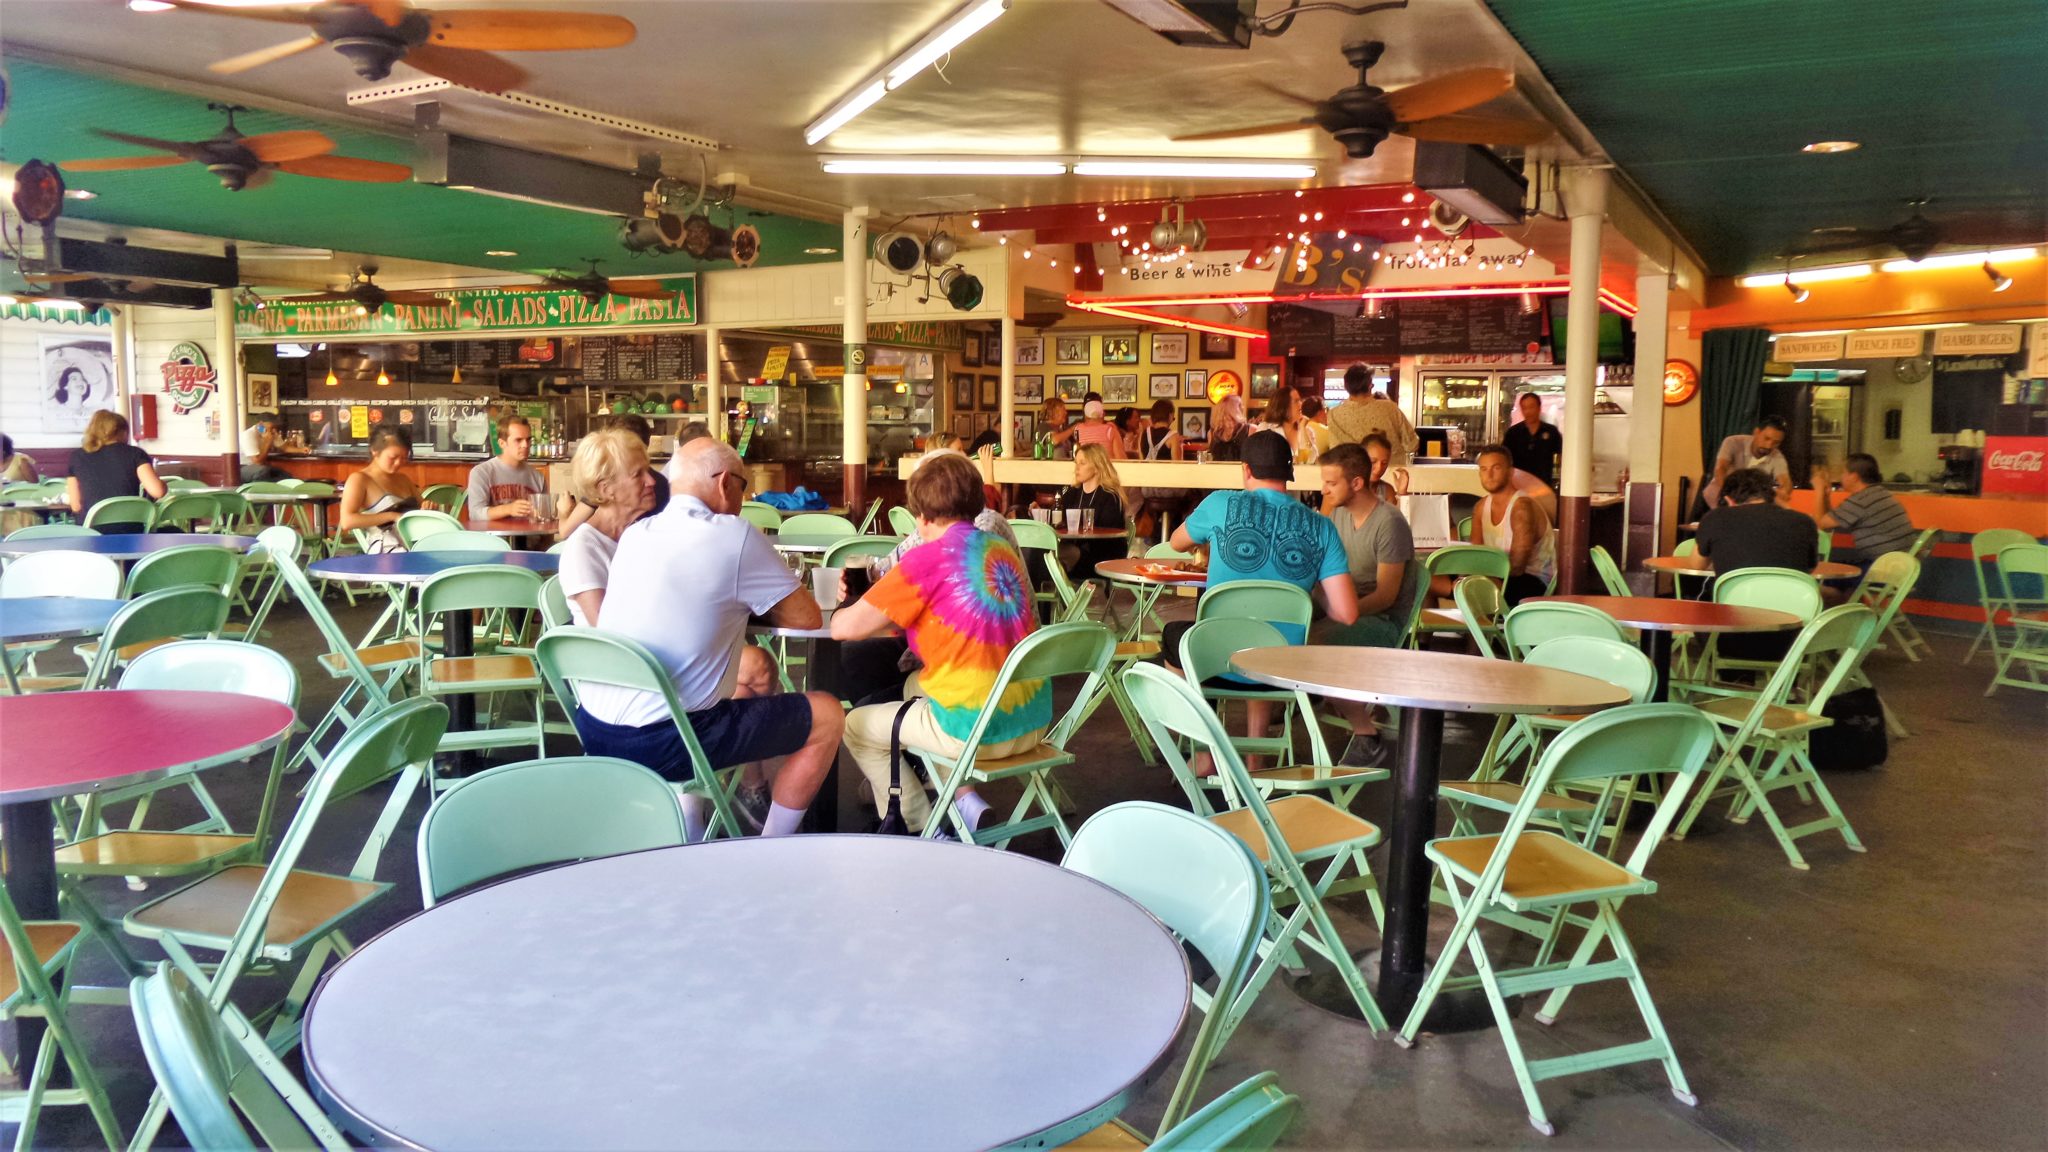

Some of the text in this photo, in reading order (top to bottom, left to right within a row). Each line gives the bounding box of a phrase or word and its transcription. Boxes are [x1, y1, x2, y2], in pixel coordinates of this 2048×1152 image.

[1391, 255, 1431, 269] fro
[1130, 264, 1231, 281] Beer & wine
[237, 289, 691, 333] SAGNA PARMESAN PANINI SALADS PIZZA PASTA
[1781, 341, 1838, 354] SANDWICHES
[1855, 337, 1917, 351] FRENCH FRIES
[1943, 333, 2013, 347] HAMBURGERS
[160, 361, 216, 393] Pizza
[1988, 449, 2045, 472] Coca-Cola
